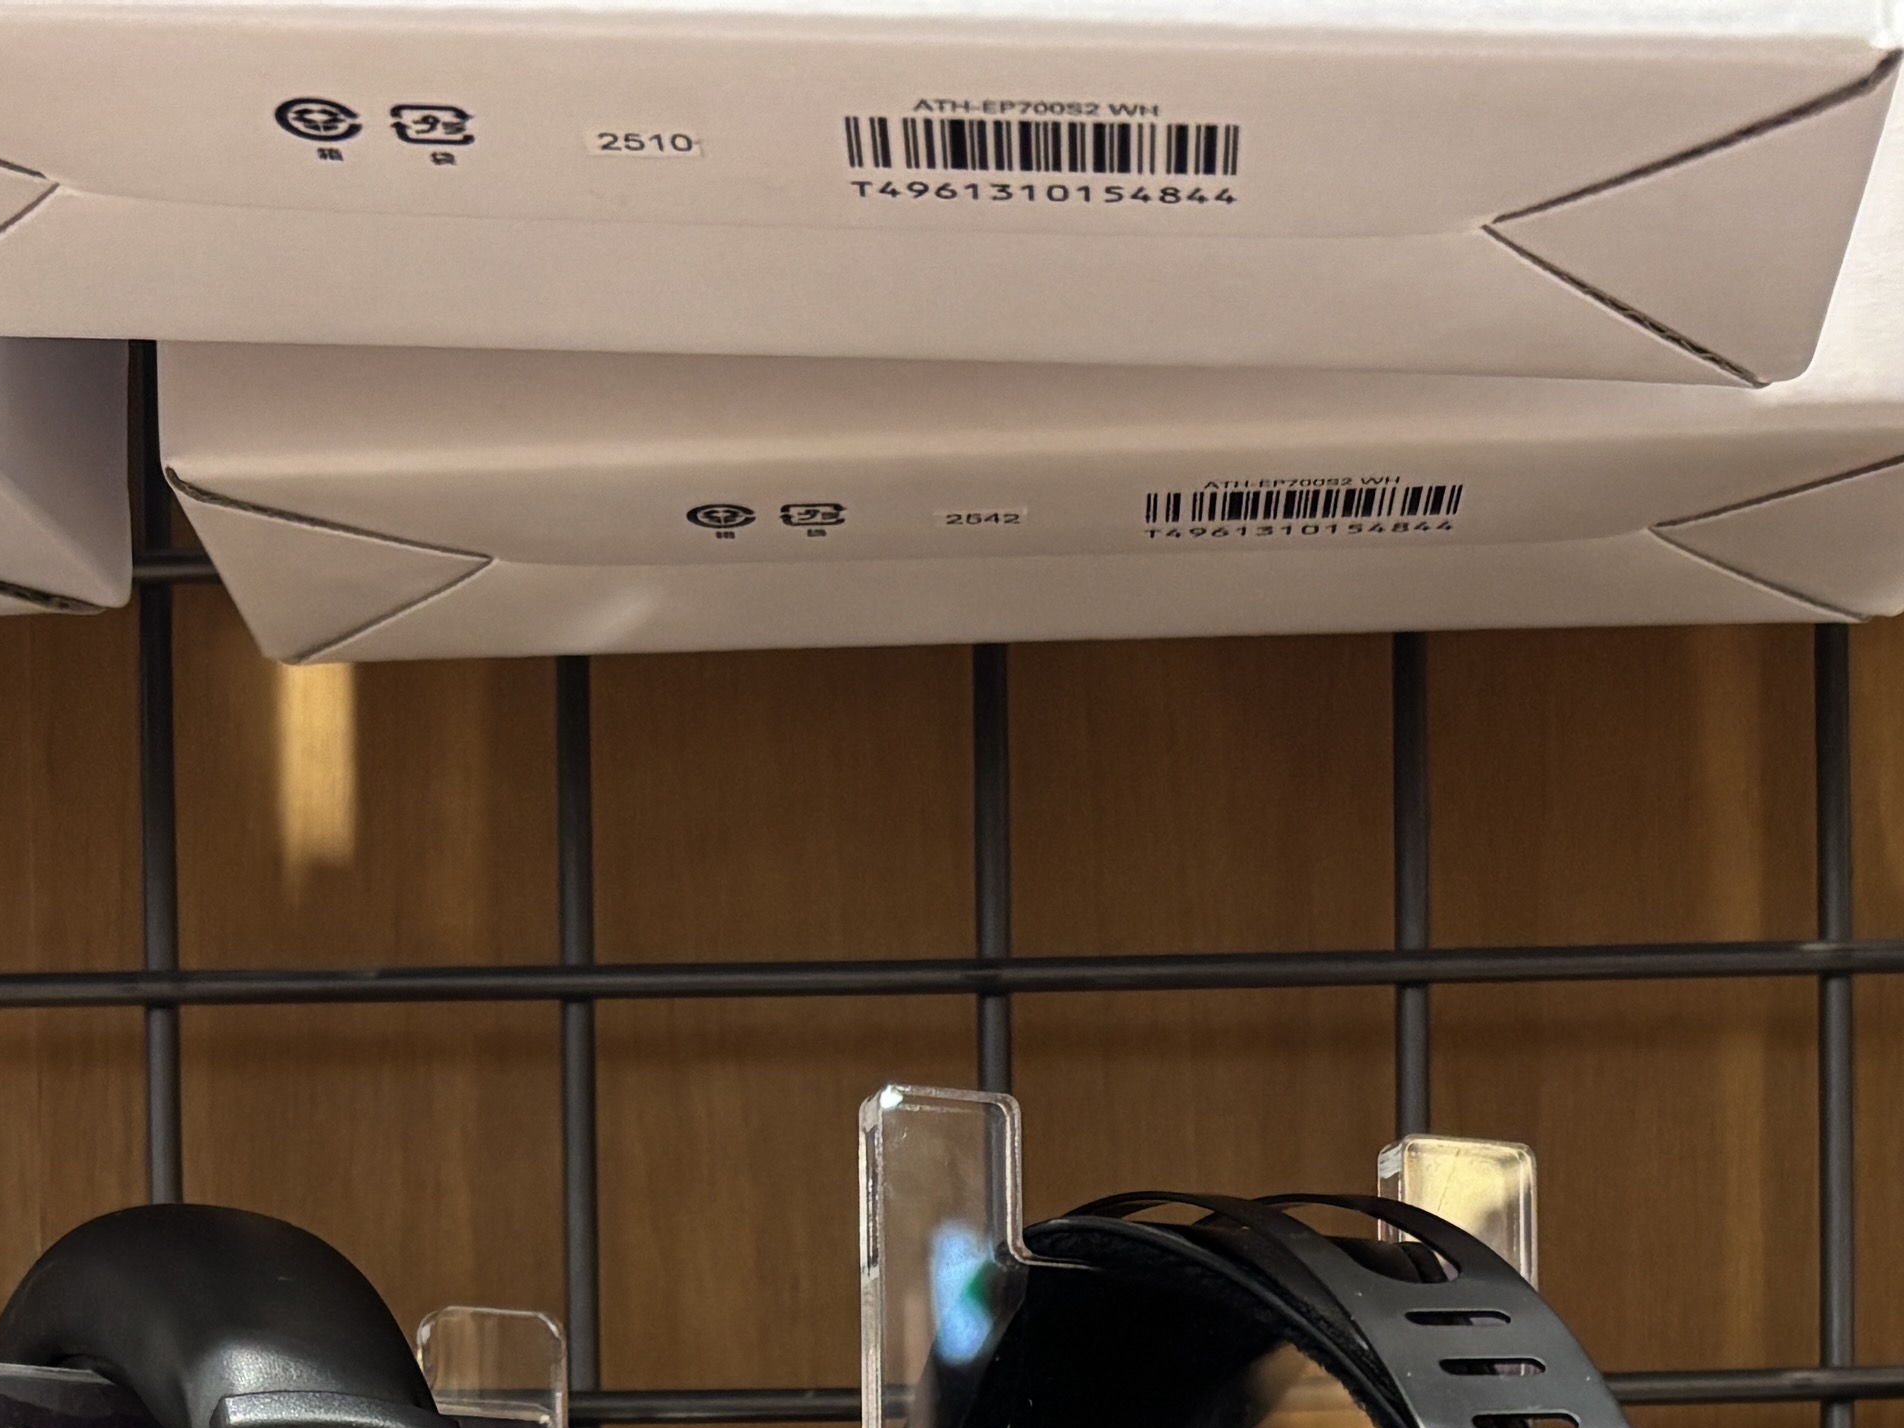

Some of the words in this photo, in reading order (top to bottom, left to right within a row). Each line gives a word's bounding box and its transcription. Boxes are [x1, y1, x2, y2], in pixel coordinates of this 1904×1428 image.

[912, 98, 1100, 117] ATH-EP700S2
[1108, 102, 1160, 118] WH
[597, 132, 693, 152] 2510
[851, 180, 1238, 206] T4961310154844
[1204, 476, 1353, 489] ATH-EP700S2
[1361, 475, 1401, 486] WH
[1144, 520, 1455, 539] T4961310154844
